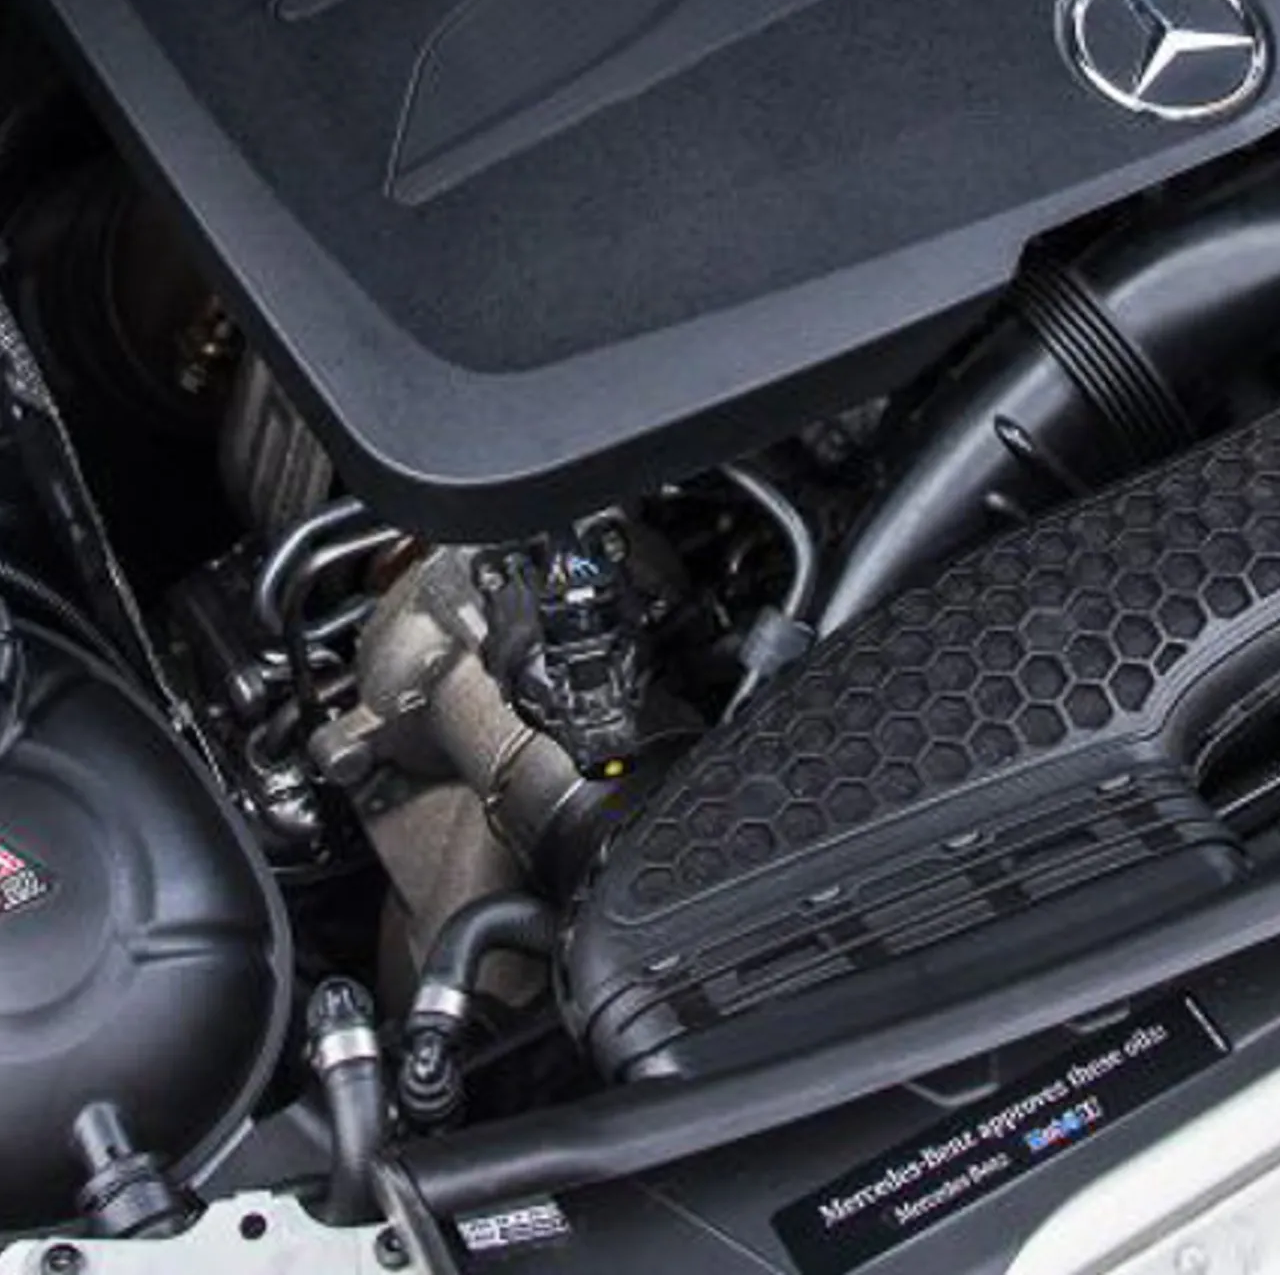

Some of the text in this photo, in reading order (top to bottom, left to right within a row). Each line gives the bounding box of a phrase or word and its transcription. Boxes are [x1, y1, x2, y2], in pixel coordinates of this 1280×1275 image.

[819, 1133, 978, 1226] Mercedes-Benz
[978, 1081, 1069, 1137] approves
[1067, 1050, 1122, 1088] these
